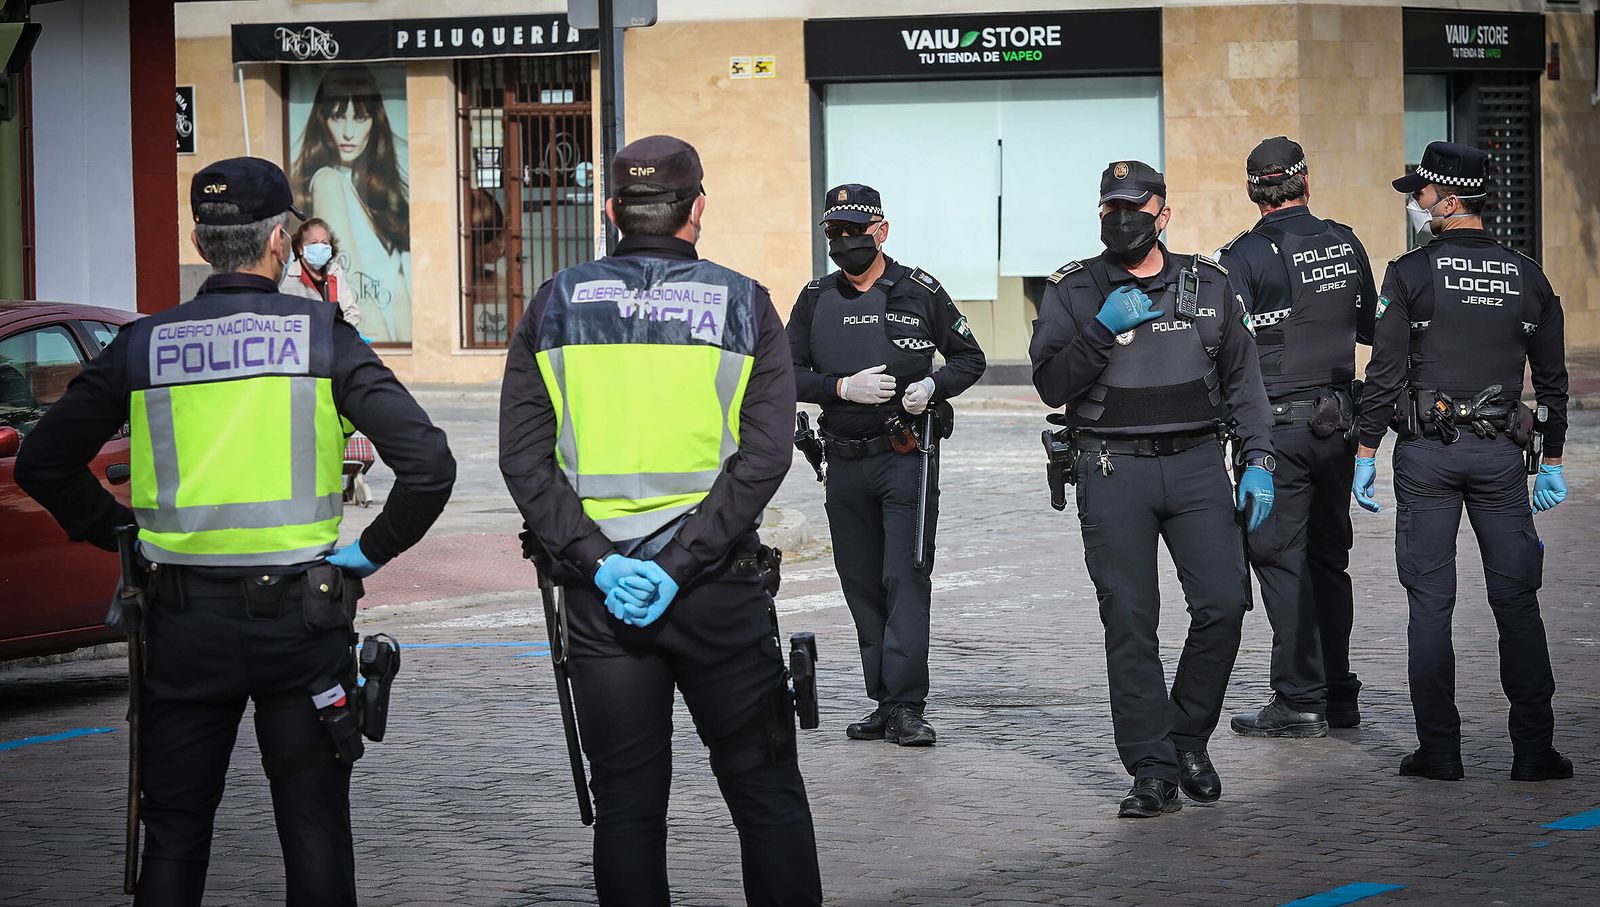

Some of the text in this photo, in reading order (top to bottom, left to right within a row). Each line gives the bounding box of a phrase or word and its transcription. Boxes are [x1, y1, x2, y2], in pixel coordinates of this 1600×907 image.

[397, 21, 580, 49] PELUQUERÍA
[901, 26, 1062, 50] VAIU STORE
[1445, 24, 1508, 45] VAIU STORE
[919, 50, 1043, 64] TU TIENDA DE VAPEO
[629, 167, 656, 177] CNP
[204, 184, 227, 194] CNP
[1293, 243, 1354, 267] POLICIA
[1301, 262, 1357, 284] LOCAL
[1437, 257, 1519, 276] POLICIA
[1315, 280, 1347, 293] JEREZ
[1444, 275, 1520, 295] LOCAL
[577, 287, 630, 301] CUERPO
[703, 292, 722, 305] DE
[1461, 296, 1504, 307] JEREZ
[158, 317, 302, 340] CUERPO NACIONAL DE
[843, 315, 879, 325] POLICIA
[1152, 320, 1192, 333] POLICIA
[157, 337, 301, 377] POLICIA
